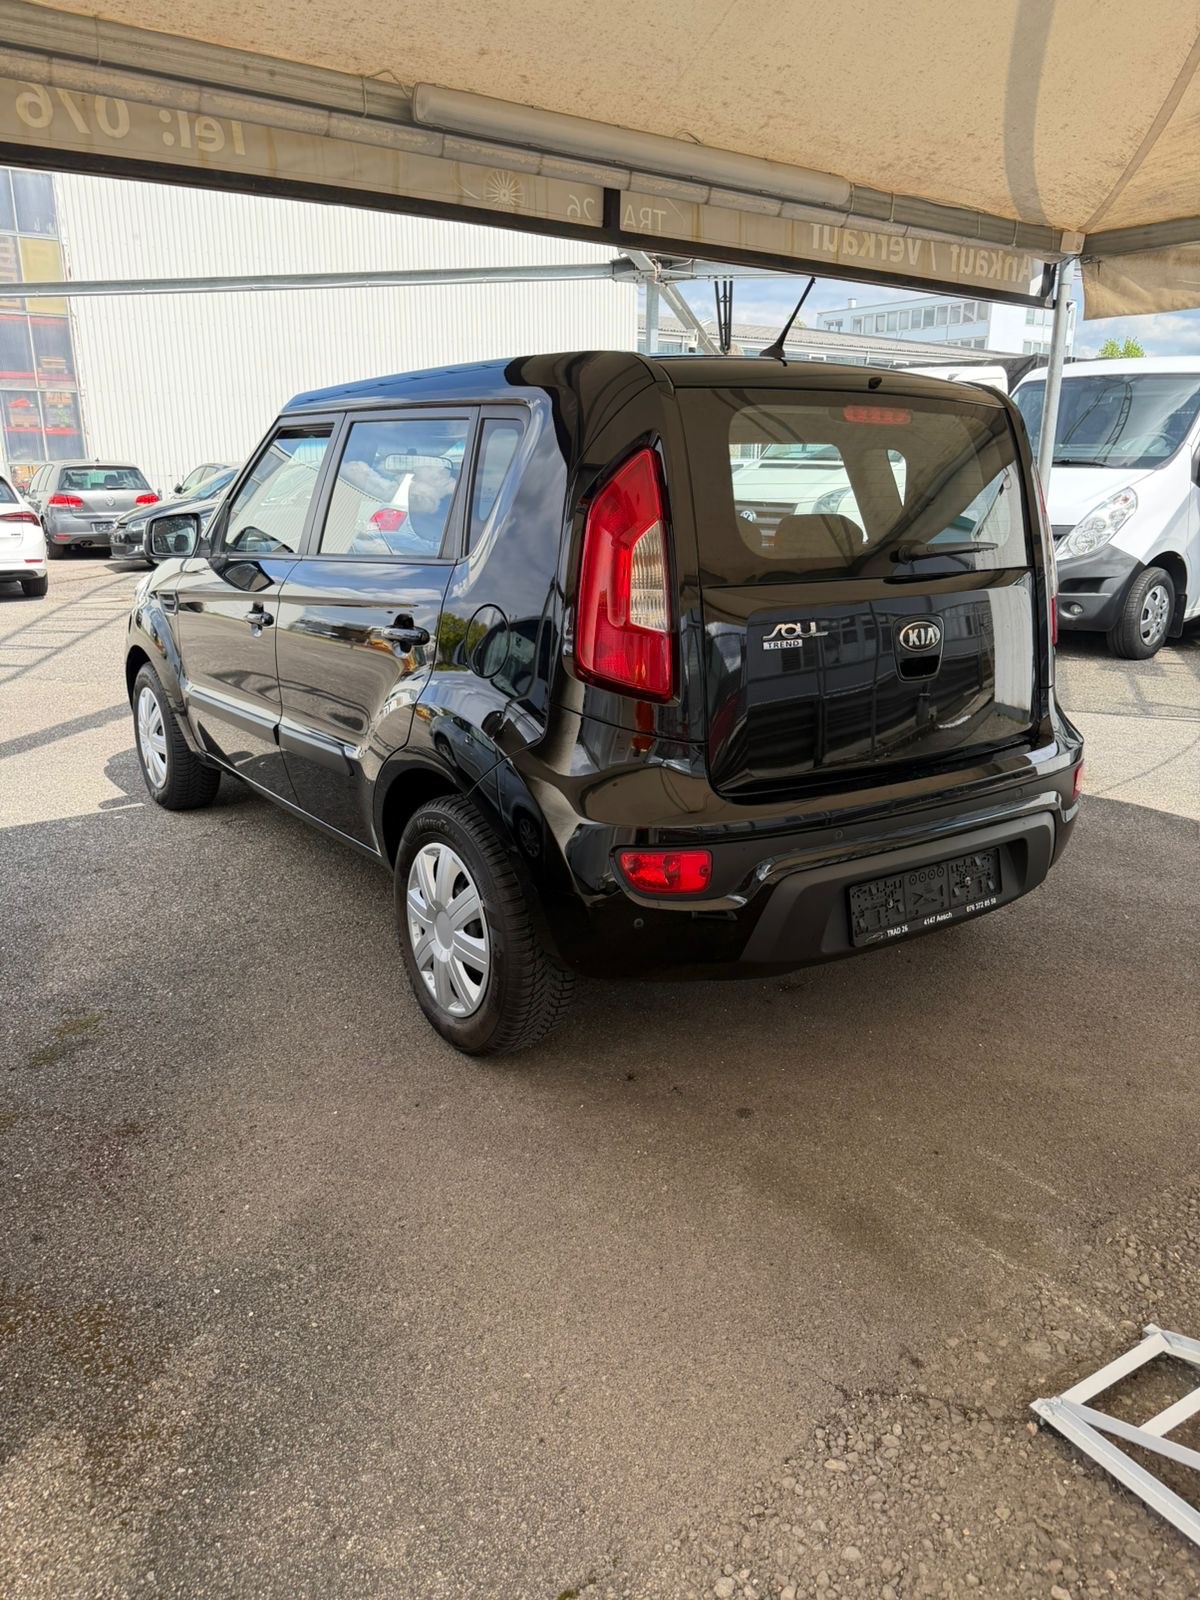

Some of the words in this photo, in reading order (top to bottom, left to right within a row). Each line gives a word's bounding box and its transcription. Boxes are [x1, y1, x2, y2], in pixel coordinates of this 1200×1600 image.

[762, 621, 829, 640] SOUL
[767, 640, 801, 649] TREND
[886, 927, 902, 937] TRAD
[901, 924, 909, 933] 26
